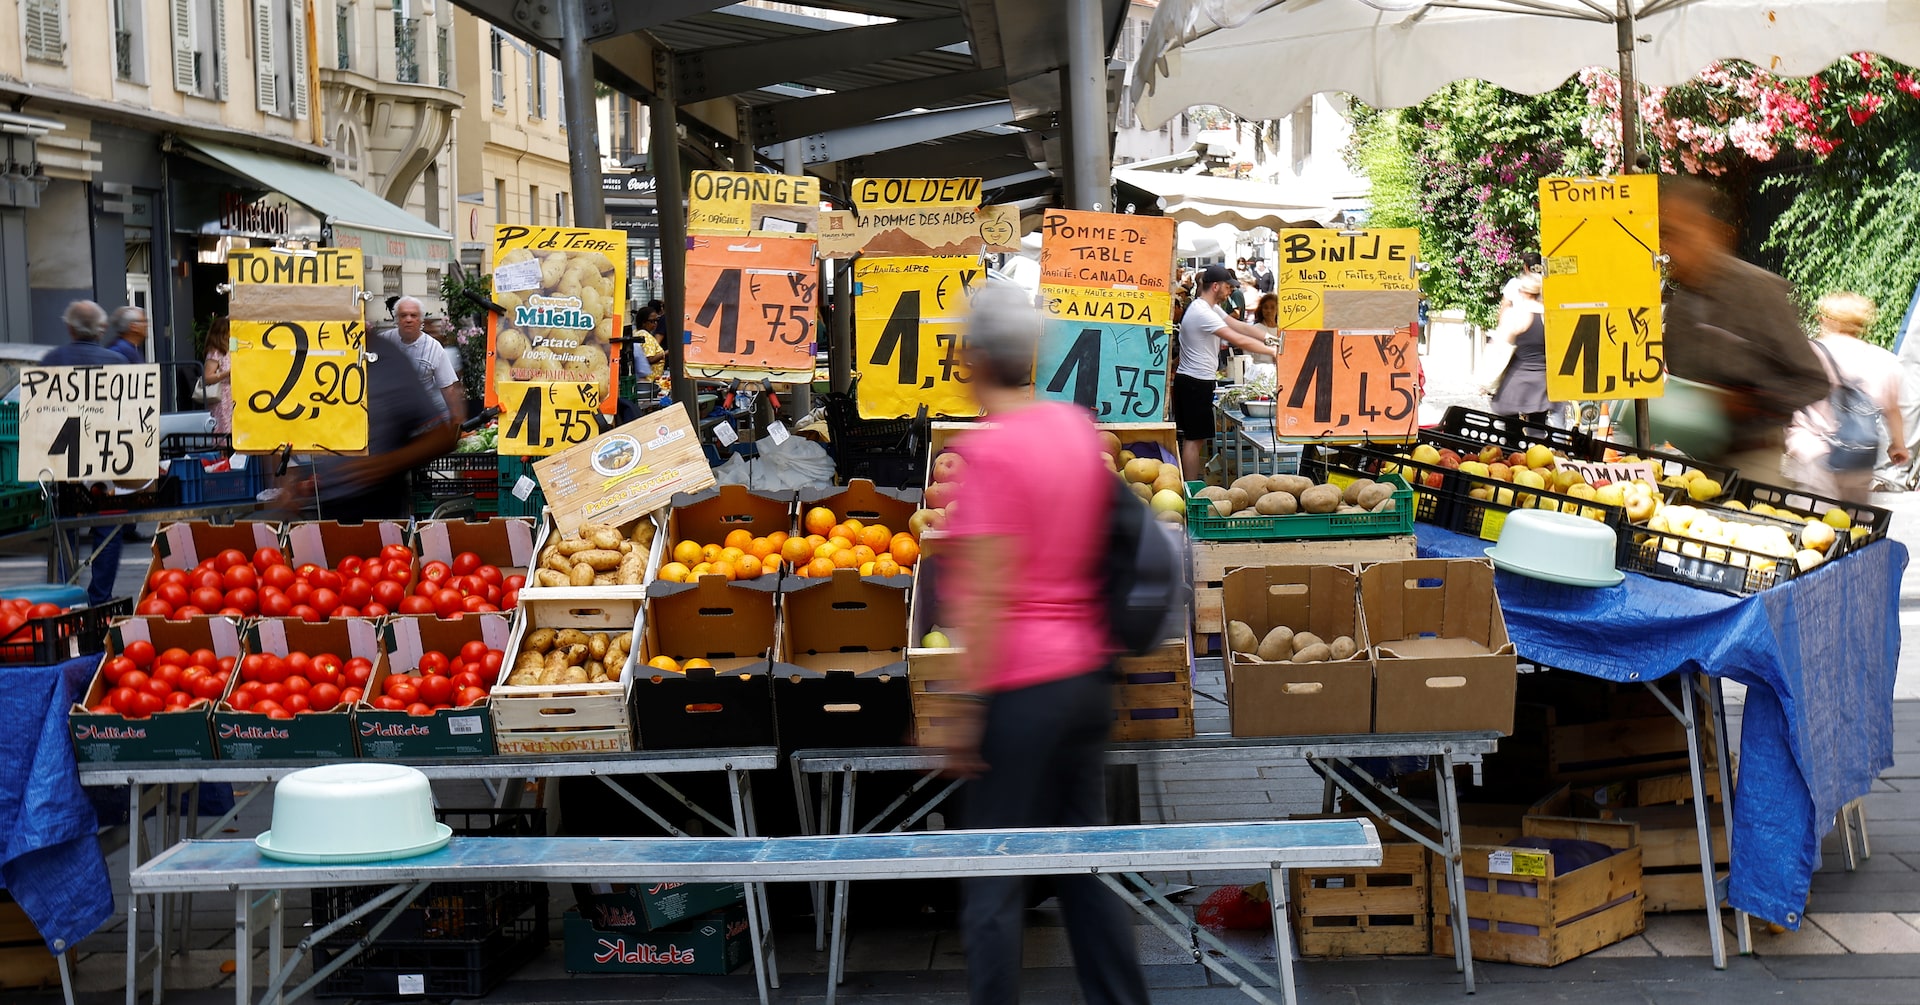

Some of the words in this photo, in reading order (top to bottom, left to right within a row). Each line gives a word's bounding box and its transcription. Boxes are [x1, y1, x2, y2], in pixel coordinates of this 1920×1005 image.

[695, 173, 809, 205] ORANGE
[862, 179, 980, 204] GOLDEN
[1548, 180, 1631, 202] POMME
[857, 215, 869, 228] LA
[873, 213, 916, 227] POMME
[919, 212, 940, 226] DES
[943, 211, 975, 225] ALPES
[1044, 214, 1116, 240] POMME
[563, 231, 619, 252] TERRE
[1070, 246, 1134, 263] TABLE
[228, 250, 354, 283] TOMATE
[903, 265, 930, 274] ALPES
[787, 271, 817, 303] Kg
[1117, 291, 1145, 299] ALPES
[516, 306, 593, 329] Milella
[695, 268, 809, 355] 1,75
[1048, 298, 1152, 323] CANADA
[342, 321, 367, 350] Kg
[1628, 306, 1650, 347] Kg
[522, 349, 546, 360] 100%
[548, 351, 586, 363] Italiane
[532, 335, 578, 349] Patate
[1374, 335, 1410, 369] Kg
[1558, 313, 1664, 394] 1,45
[248, 321, 365, 421] 2,20
[1046, 328, 1165, 419] 1,75
[1287, 330, 1414, 427] 1,45
[22, 366, 157, 421] PASTEQUE
[577, 383, 598, 408] Kg
[139, 405, 157, 448] Kg
[505, 386, 592, 448] 1,75
[48, 416, 134, 478] 1,75
[584, 490, 628, 514] Patate
[630, 468, 680, 496] Novelle
[550, 738, 619, 752] NOVELLE
[594, 938, 695, 965] Kallisté
